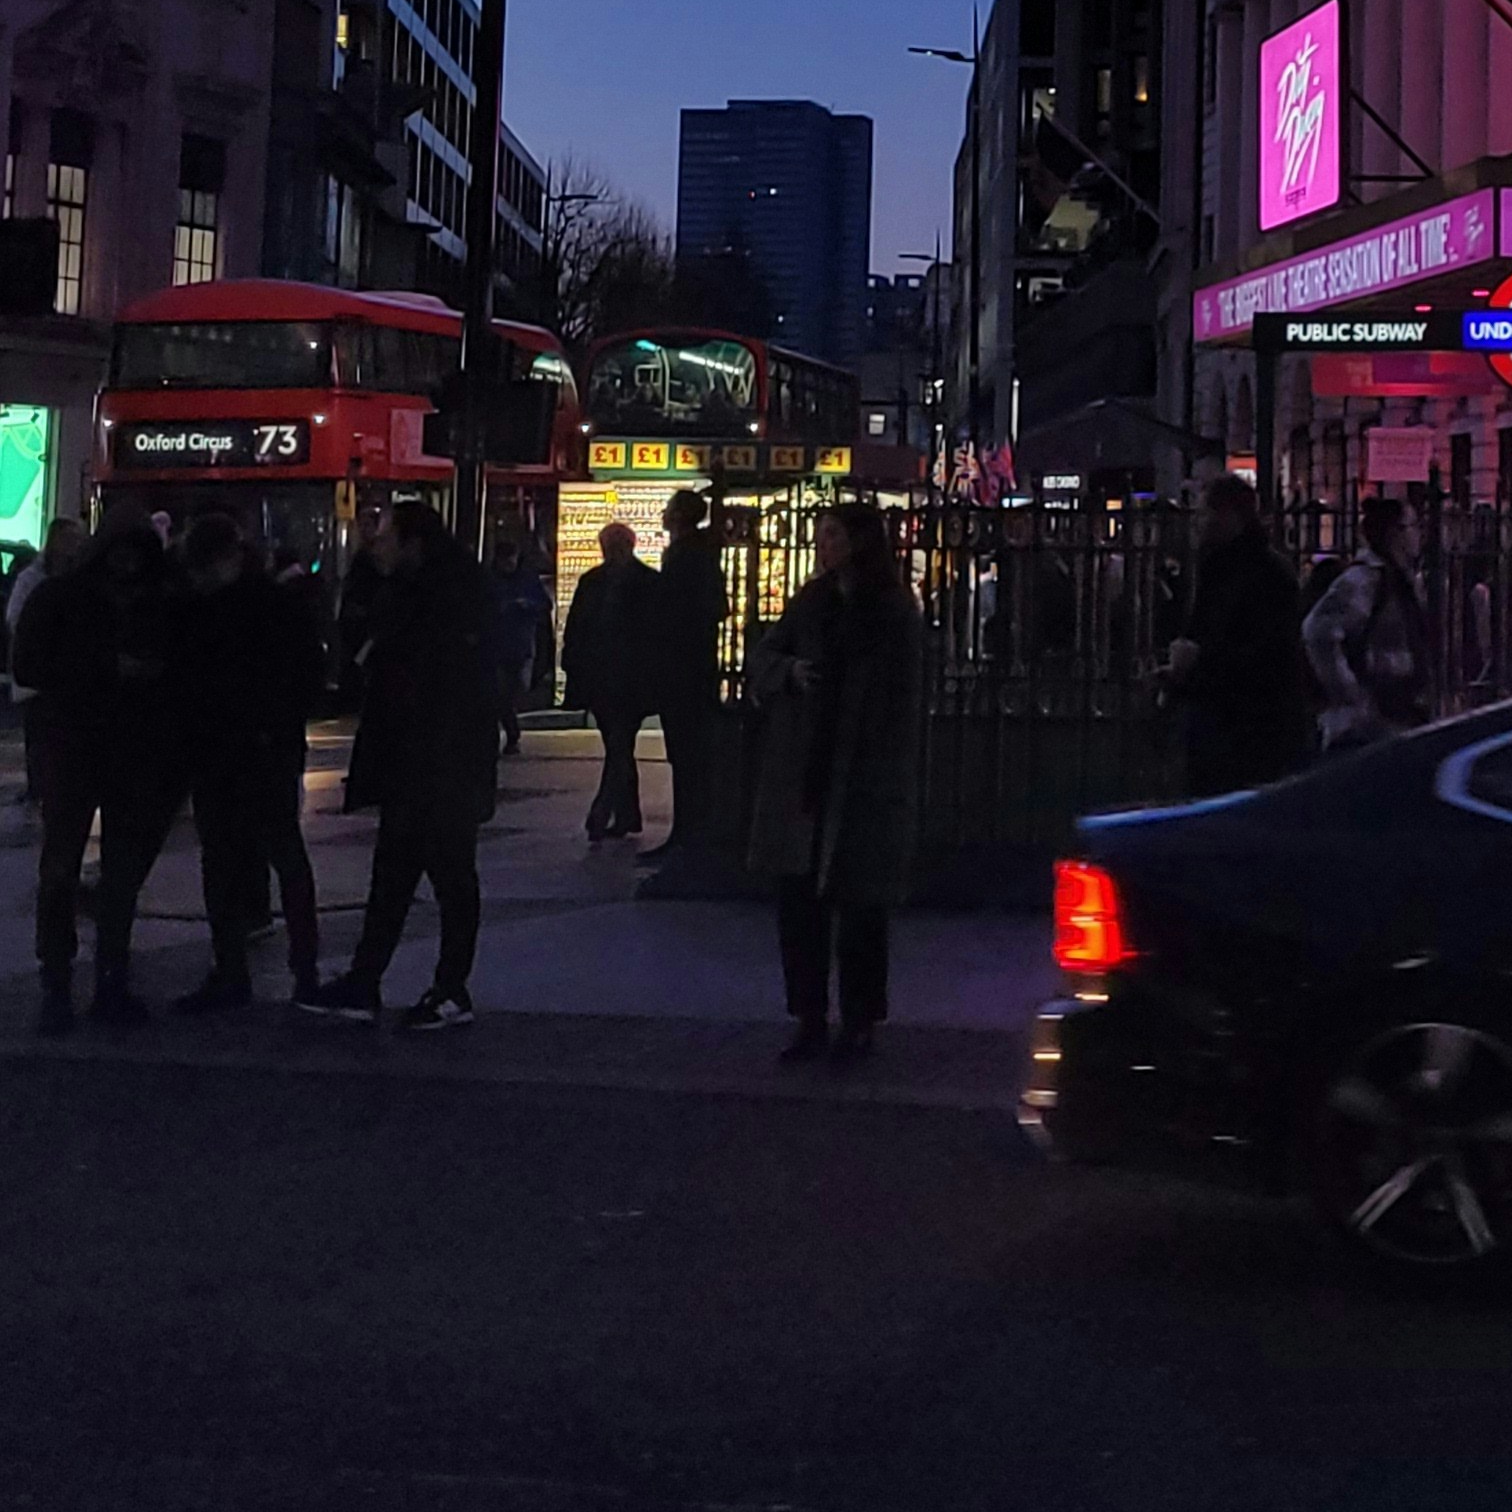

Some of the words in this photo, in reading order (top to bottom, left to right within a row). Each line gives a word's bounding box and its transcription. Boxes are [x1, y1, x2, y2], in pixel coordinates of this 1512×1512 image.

[1397, 225, 1418, 277] ALL
[1420, 213, 1450, 270] TIME
[1286, 322, 1350, 342] PUBLIC
[1353, 322, 1427, 341] SUBWAY
[135, 433, 186, 451] Oxford
[189, 433, 233, 450] Circus
[259, 425, 297, 455] 73
[594, 446, 621, 464] £1
[638, 446, 663, 464] £1
[681, 446, 704, 464] £1
[821, 447, 844, 465] £1
